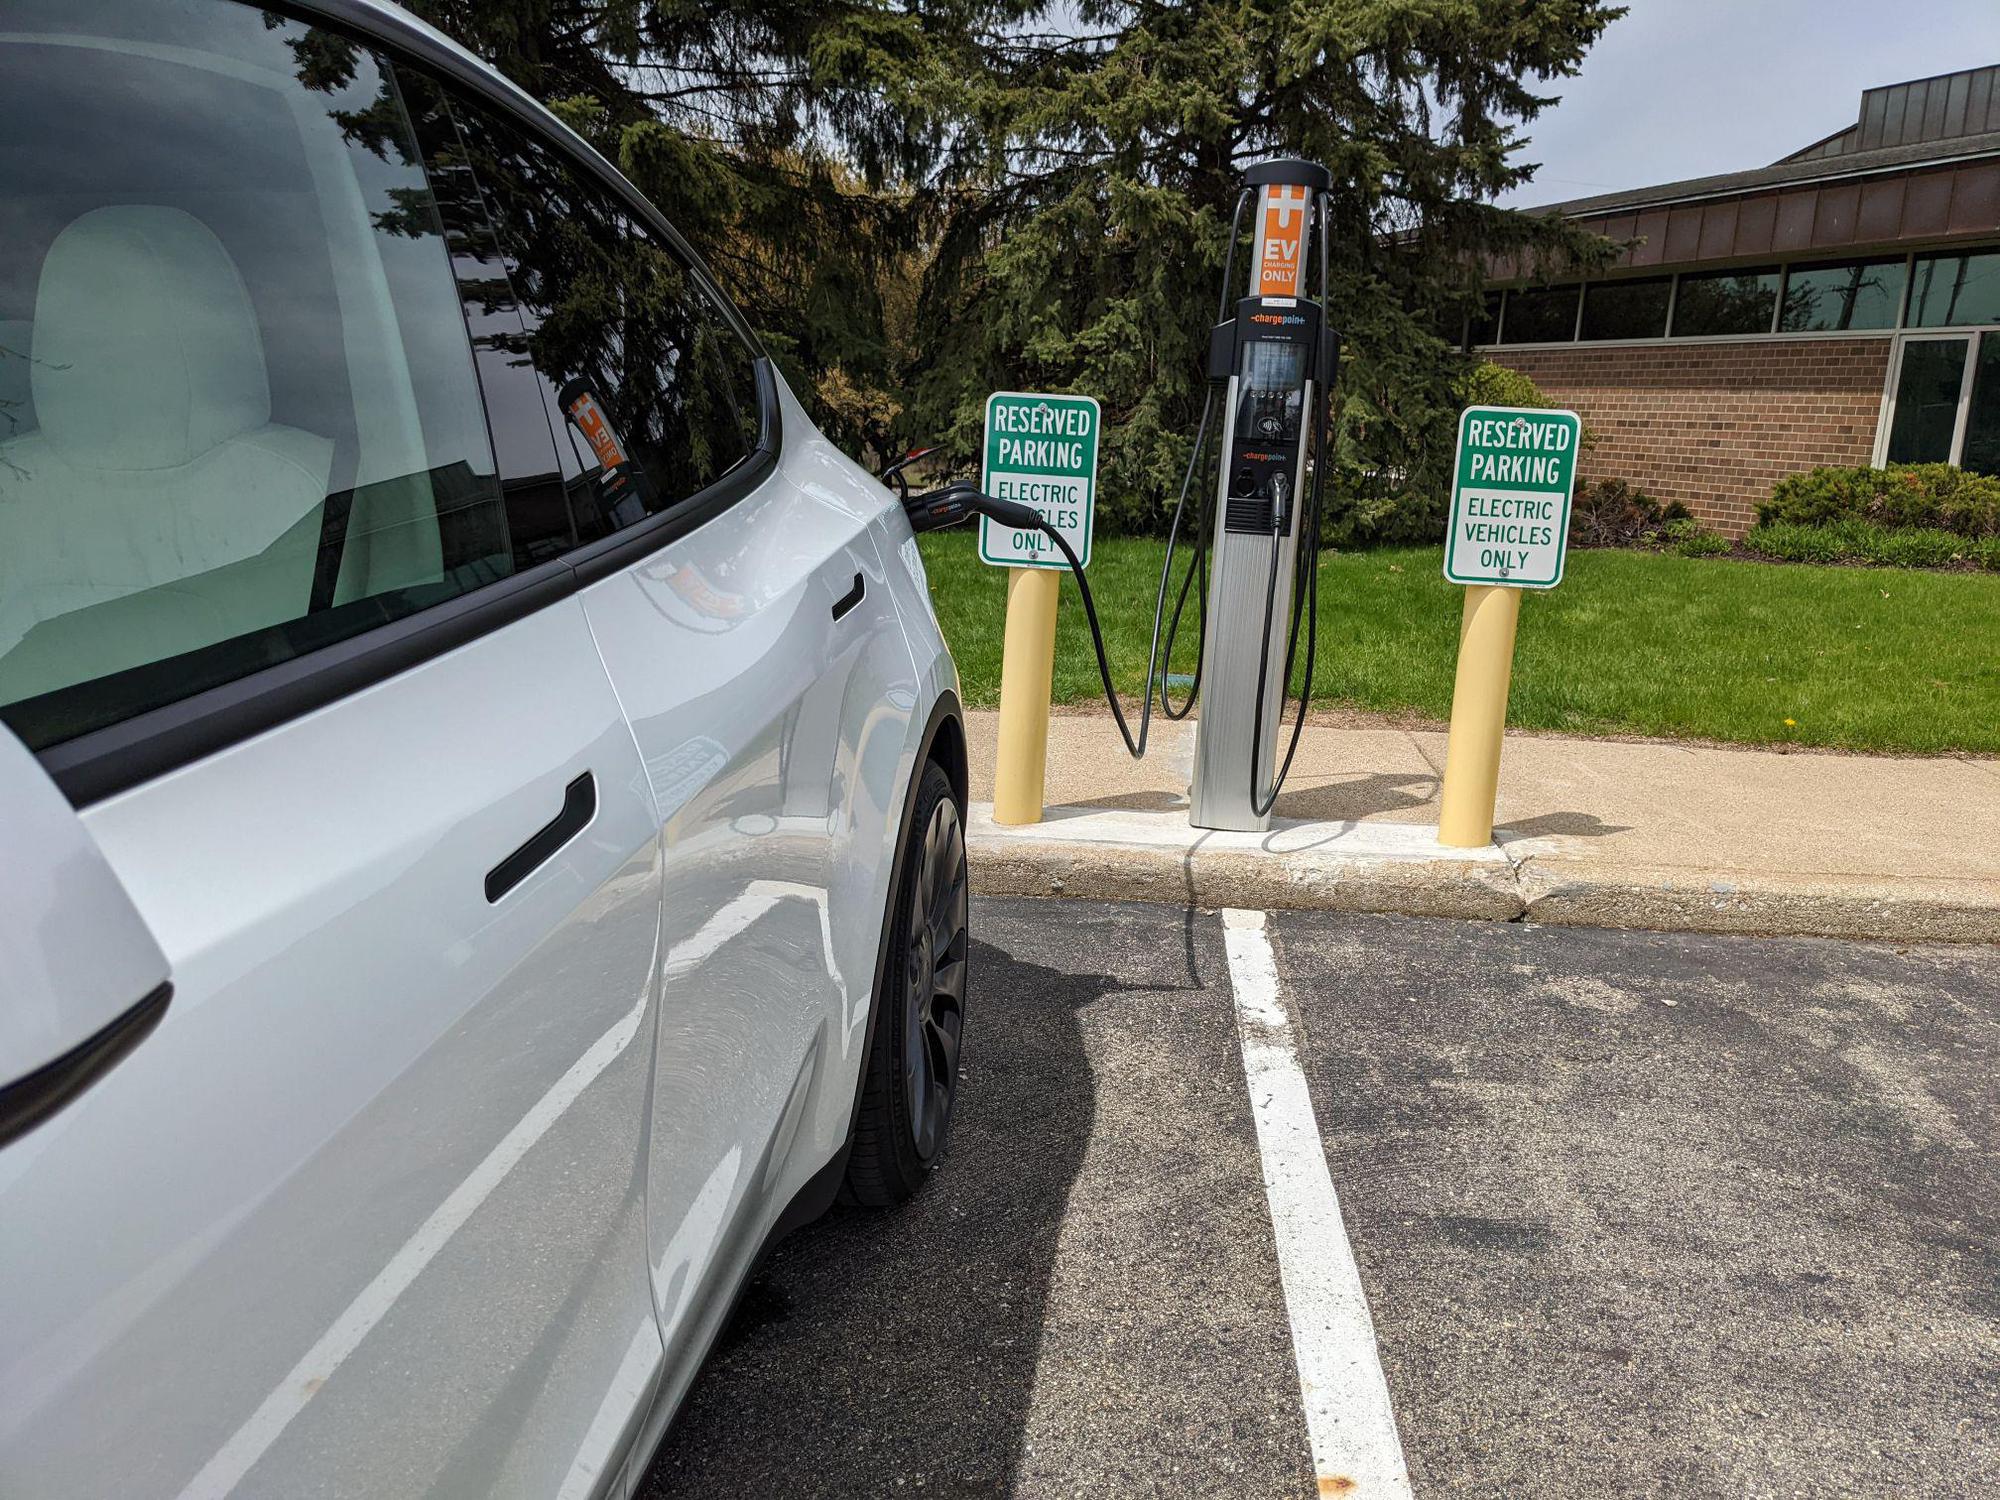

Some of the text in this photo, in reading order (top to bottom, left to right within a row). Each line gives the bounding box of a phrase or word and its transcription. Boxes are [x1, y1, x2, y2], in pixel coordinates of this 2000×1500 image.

[1264, 239, 1298, 260] EV
[1263, 270, 1295, 282] ONLY
[994, 405, 1090, 437] RESERVED
[1468, 419, 1570, 451] RESERVED
[998, 438, 1083, 469] PARKING
[1470, 453, 1560, 485] PARKING
[998, 481, 1078, 504] ELECTRIC
[1467, 497, 1554, 520] ELECTRIC
[1465, 522, 1552, 546] VEHICLES
[1480, 549, 1529, 570] ONLY
